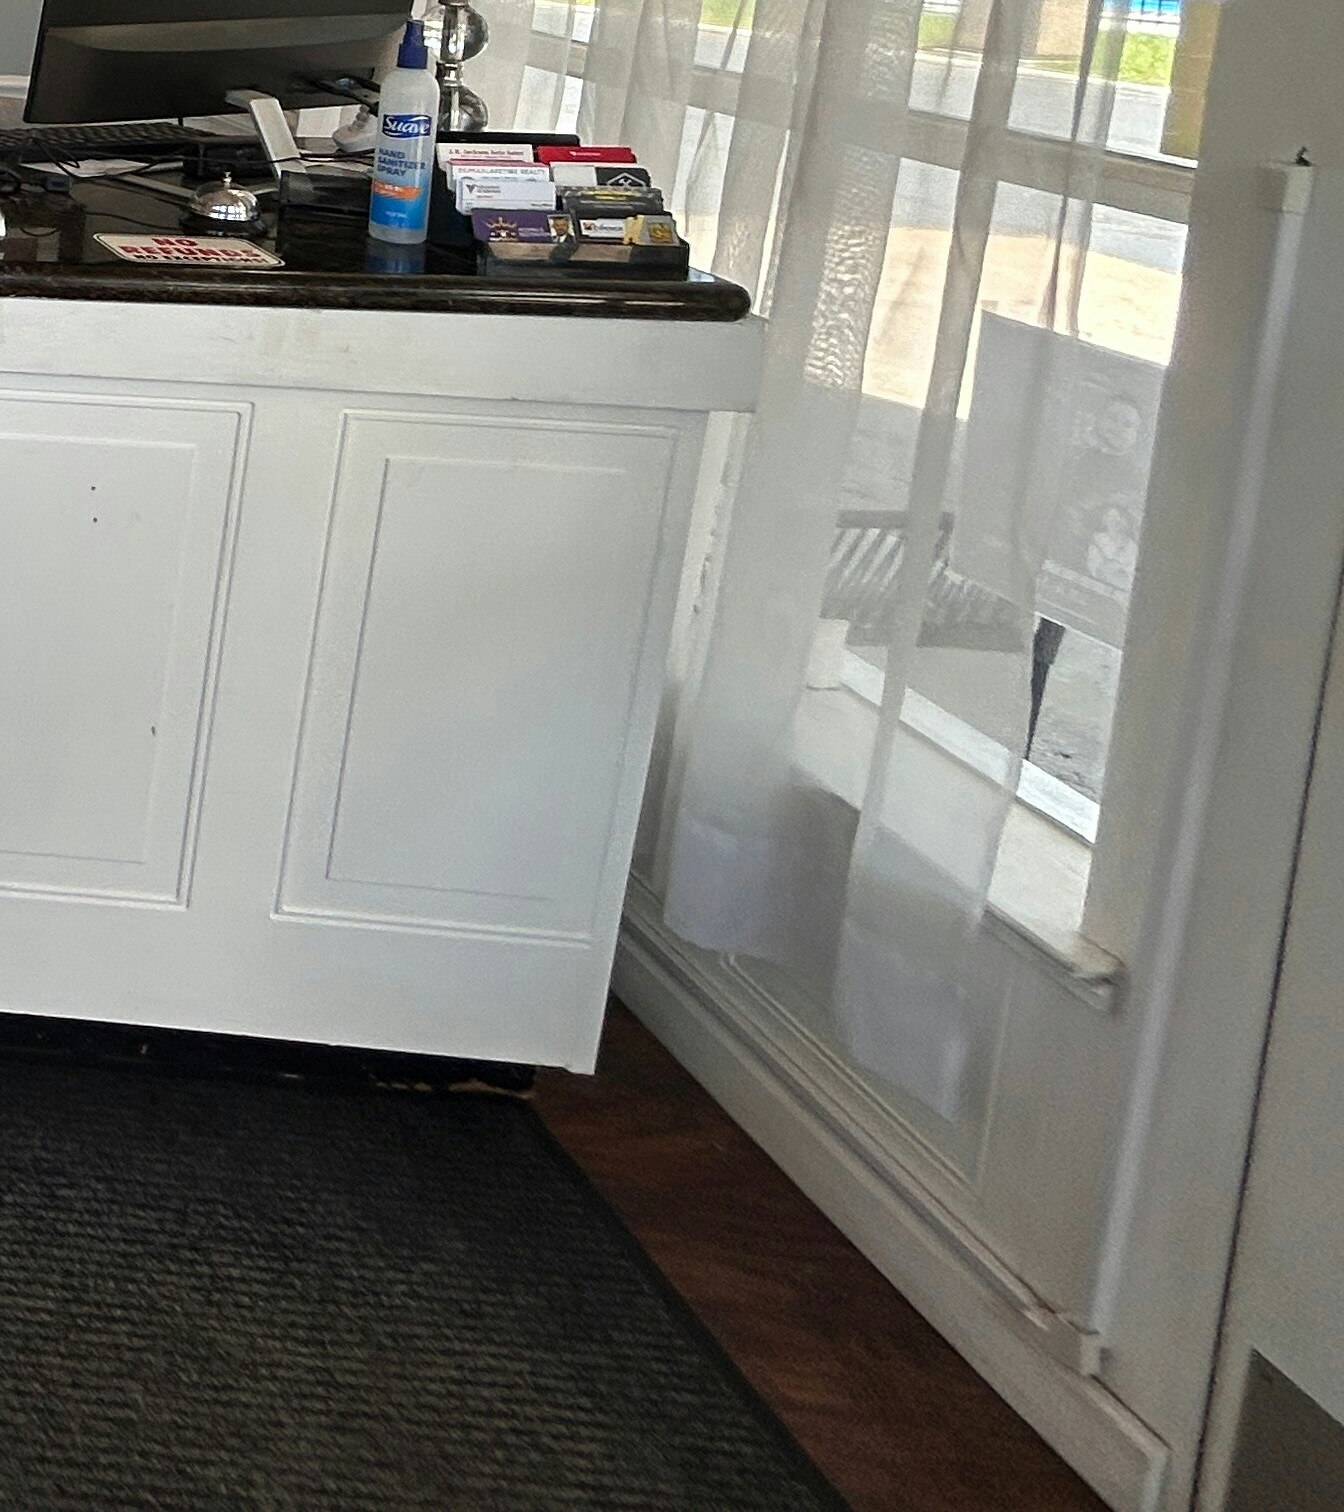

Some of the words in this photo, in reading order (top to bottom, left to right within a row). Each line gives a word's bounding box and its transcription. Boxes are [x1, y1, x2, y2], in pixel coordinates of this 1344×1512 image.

[385, 115, 430, 134] Suave
[379, 148, 405, 159] HAND
[377, 156, 426, 170] SANITIZER
[377, 164, 407, 177] SPRAY
[151, 238, 199, 246] NO
[118, 245, 262, 258] REFUNDS
